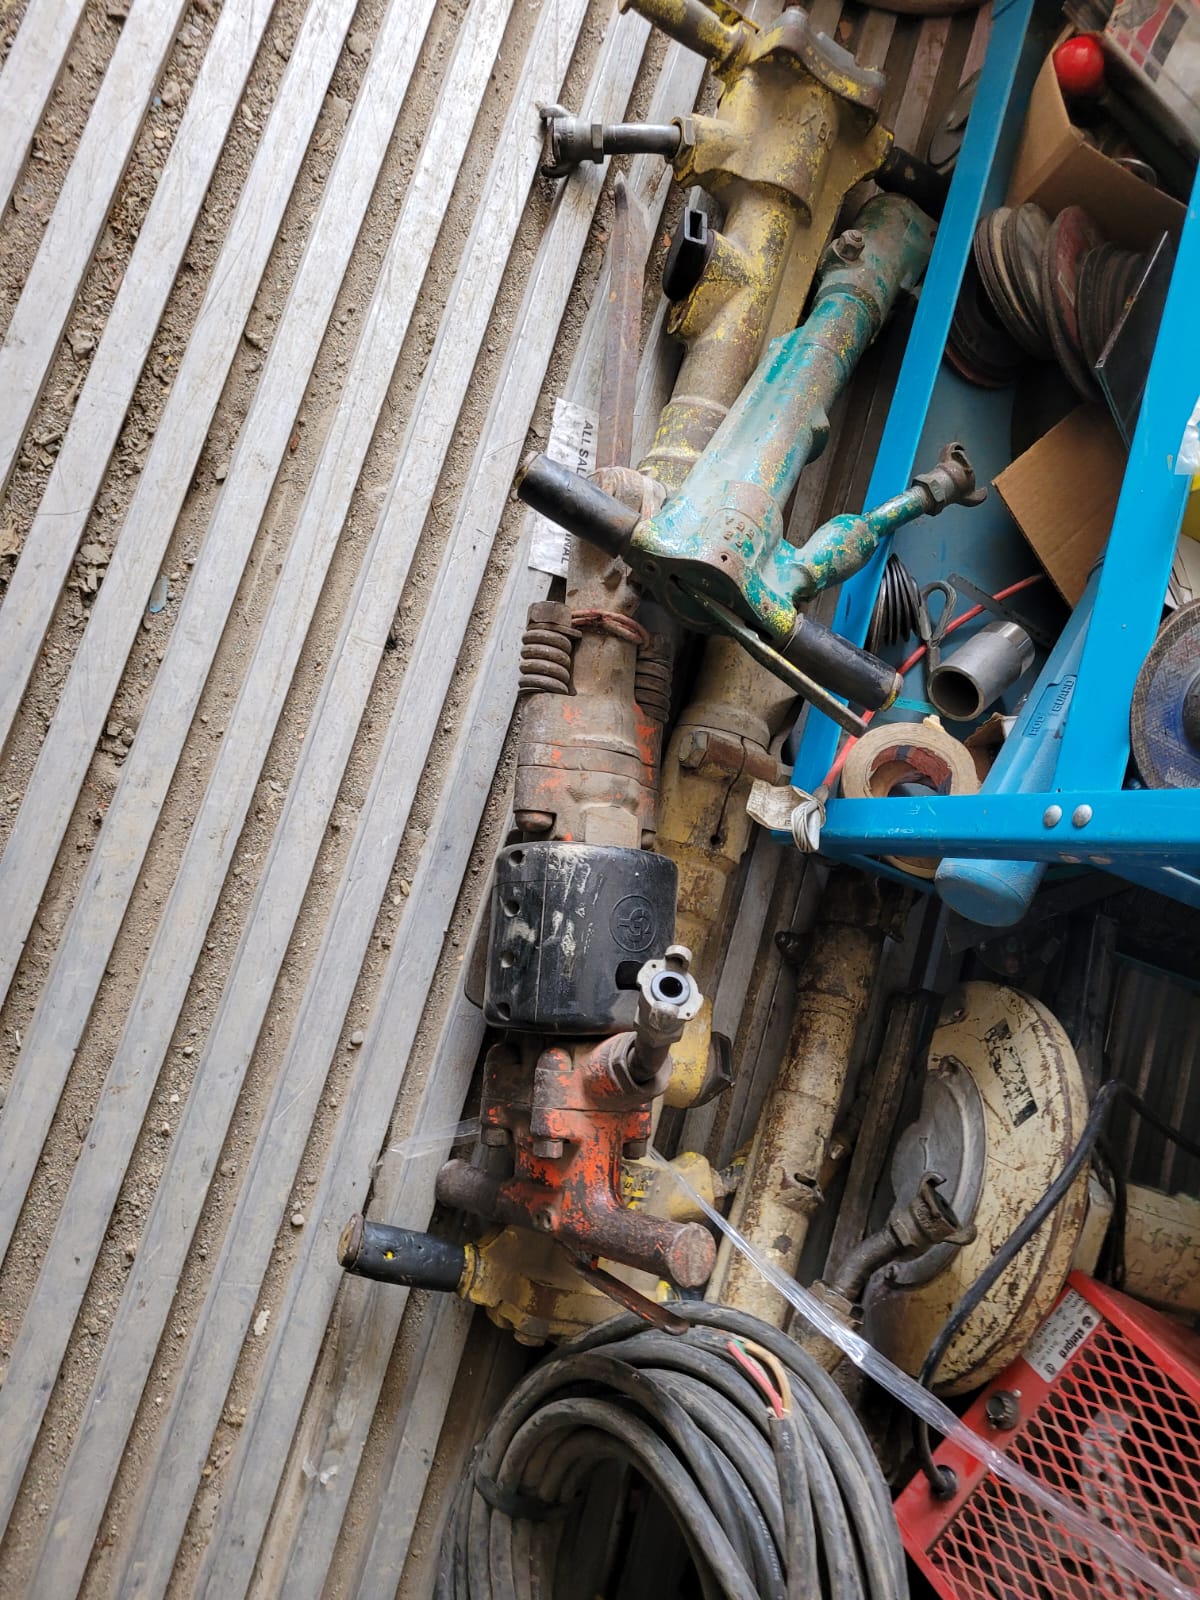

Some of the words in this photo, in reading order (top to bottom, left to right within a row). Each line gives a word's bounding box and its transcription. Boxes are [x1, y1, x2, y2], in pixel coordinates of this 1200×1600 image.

[581, 420, 593, 445] ALL
[576, 448, 589, 474] SAL
[1051, 680, 1075, 712] GUARD
[1058, 1327, 1085, 1359] stelpro
